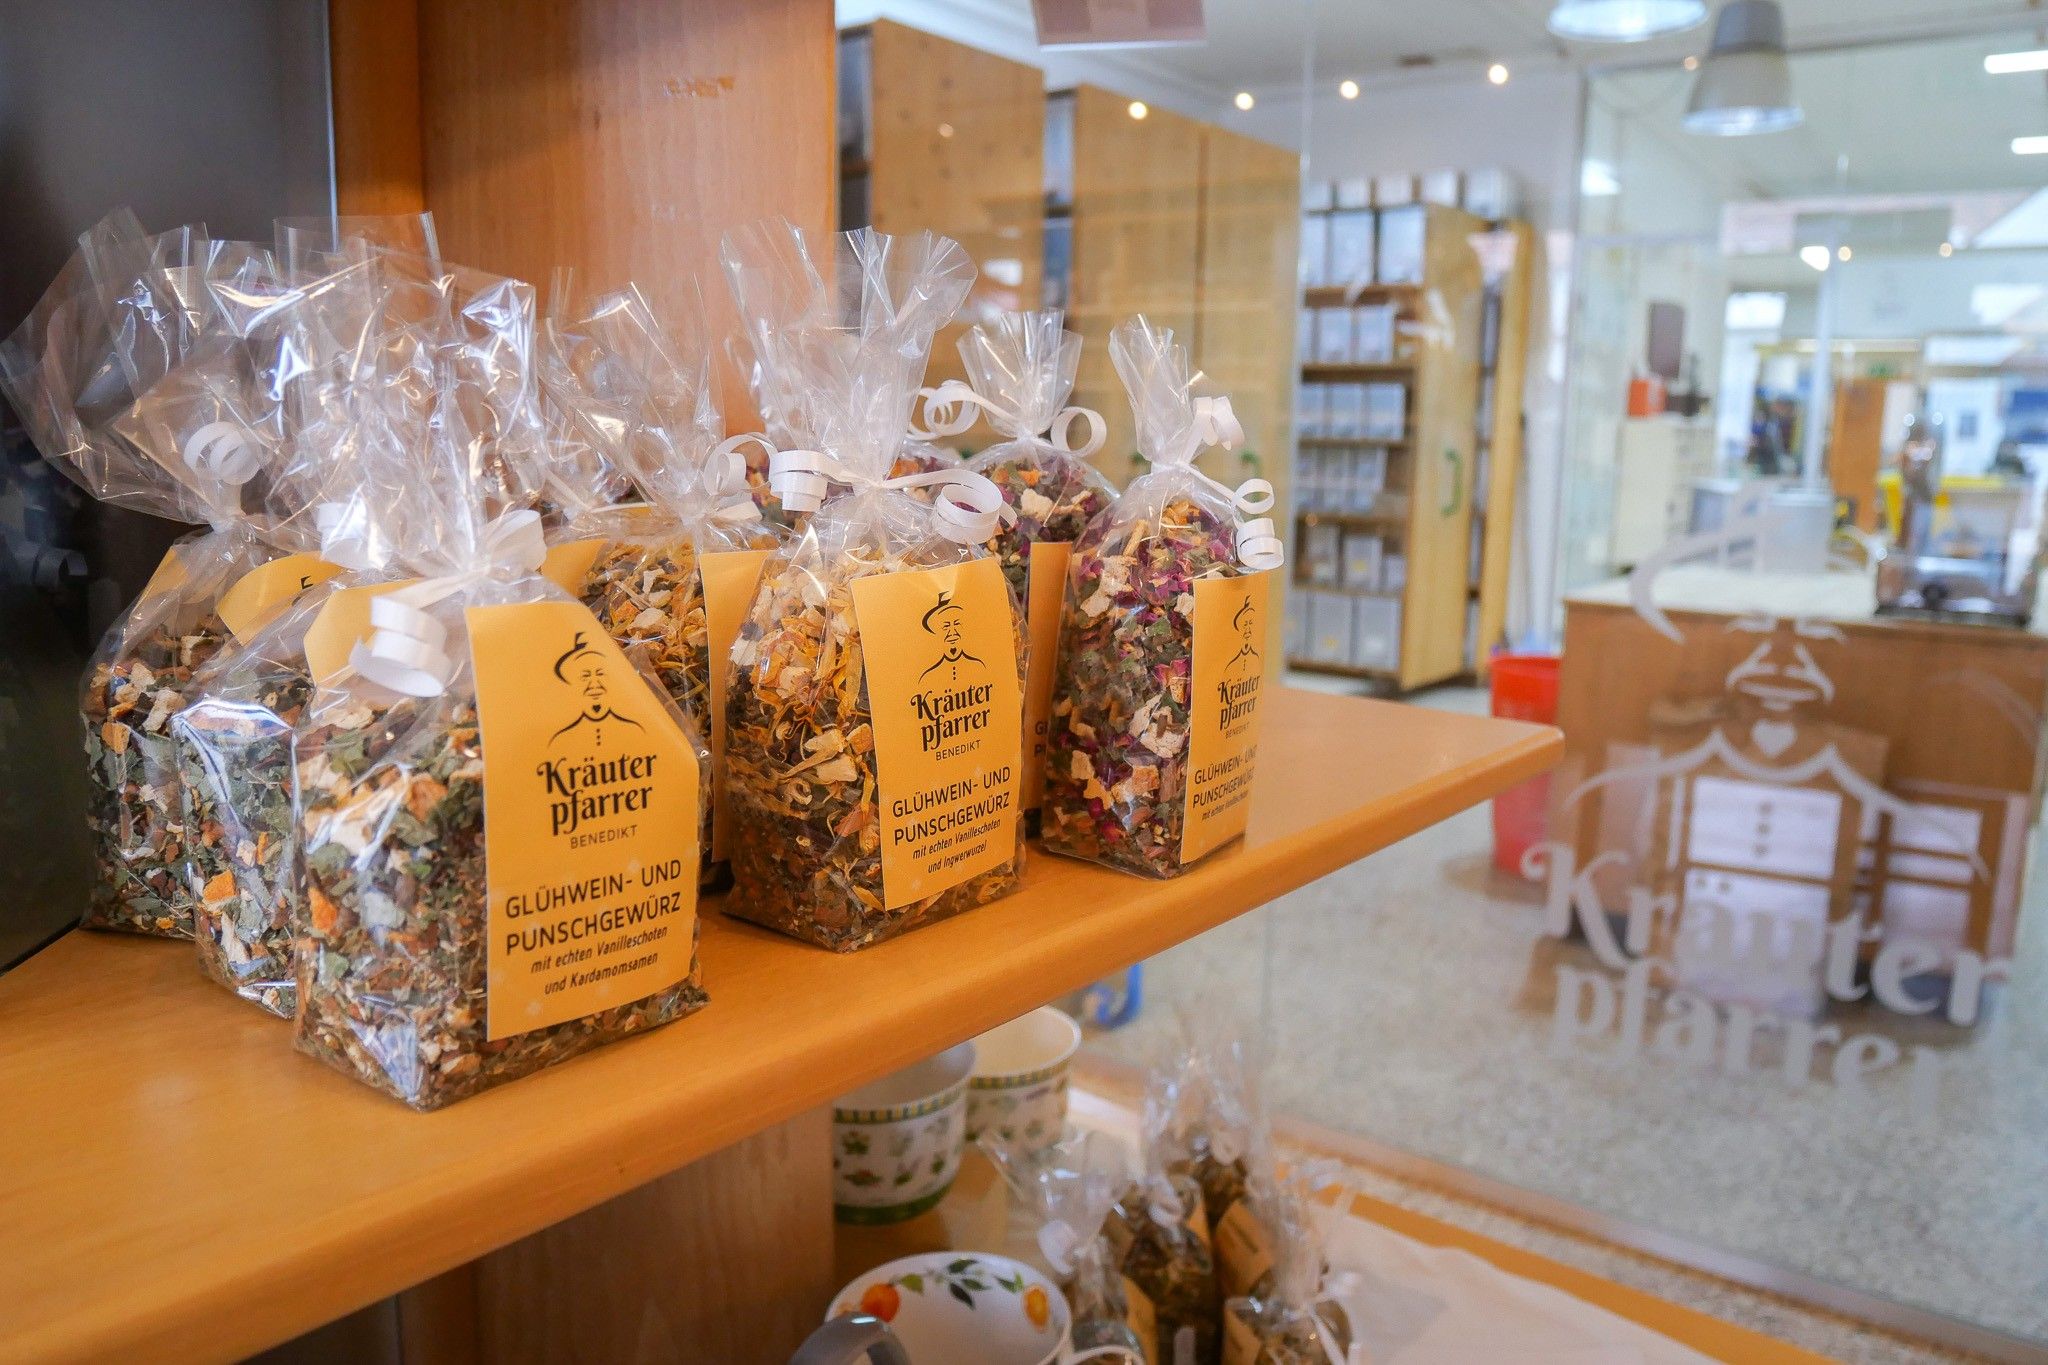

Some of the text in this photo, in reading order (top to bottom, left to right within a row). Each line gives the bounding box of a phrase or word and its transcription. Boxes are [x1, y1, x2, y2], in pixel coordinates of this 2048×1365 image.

[910, 683, 993, 721] Kräuter
[1217, 675, 1260, 705] Kräuter
[921, 709, 990, 752] pfarrer
[1220, 696, 1257, 731] pfarrer
[935, 739, 981, 761] BENEDIKT
[537, 753, 657, 797] Kräuter
[892, 766, 1011, 818] GLÜHWEIN- UND
[551, 786, 653, 836] pfarrer
[894, 791, 1010, 846] PUNSCHGEWÜRZ
[570, 824, 638, 849] BENEDIKT
[912, 819, 1001, 860] mit echten Vanilleschoten
[928, 840, 988, 873] und Ingwerwurzel
[506, 859, 681, 919] GLÜHWEIN- UND
[506, 891, 681, 956] PUNSCHGEWÜRZ
[531, 926, 668, 973] mit echten Vanilleschoten
[544, 952, 658, 995] und Kardamomsamen
